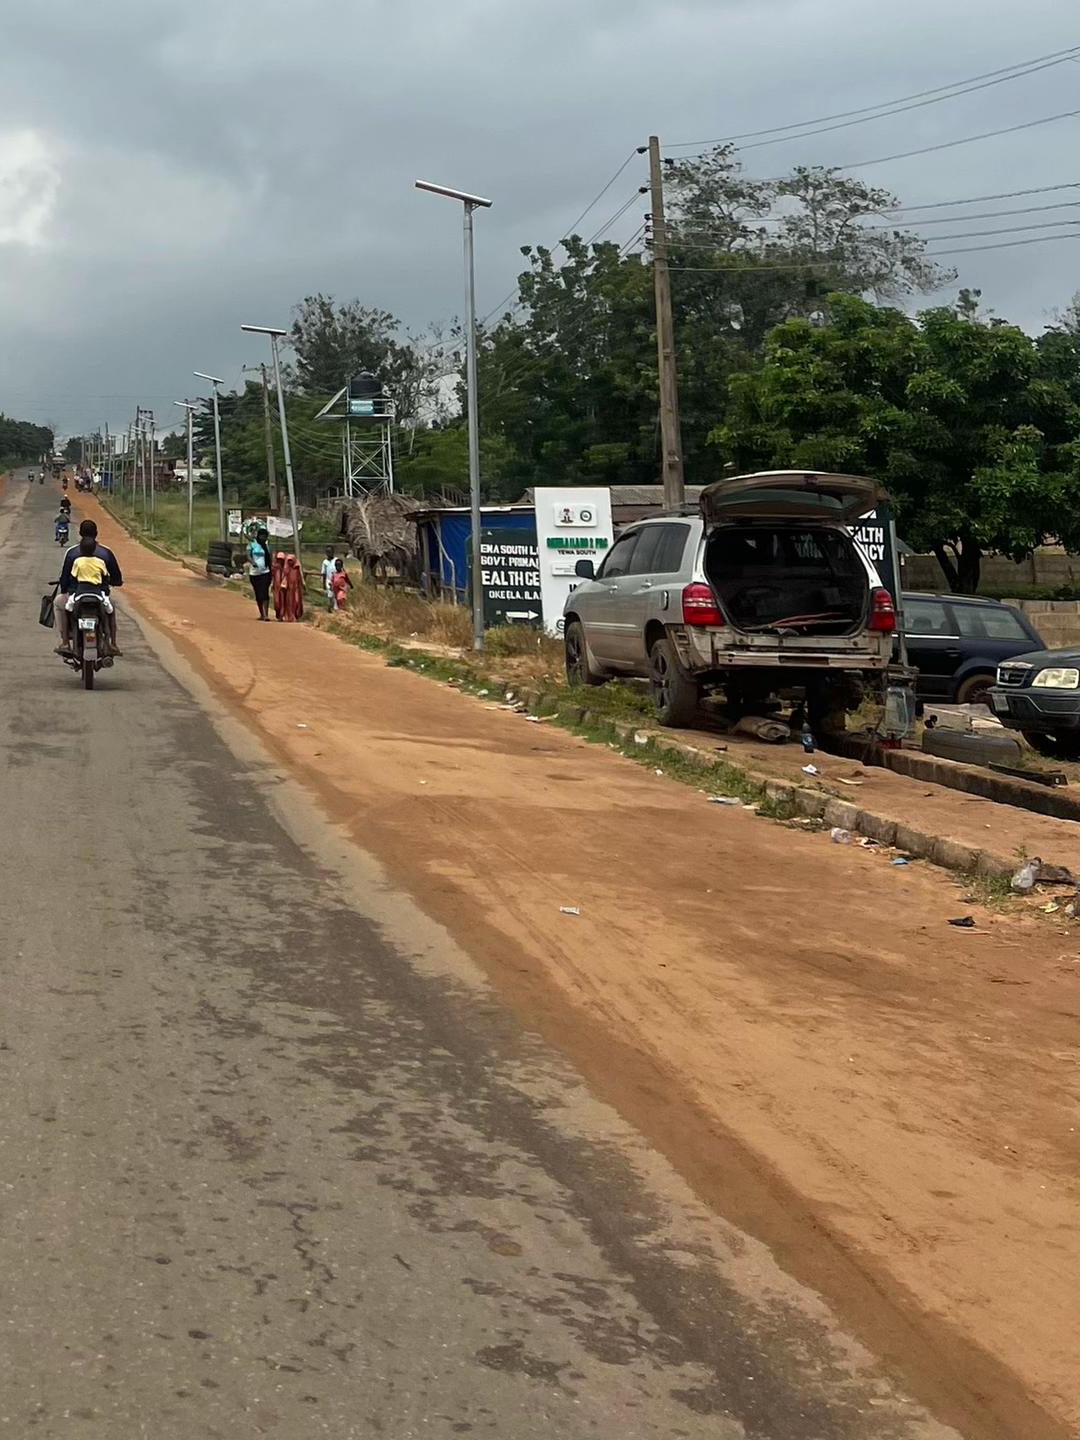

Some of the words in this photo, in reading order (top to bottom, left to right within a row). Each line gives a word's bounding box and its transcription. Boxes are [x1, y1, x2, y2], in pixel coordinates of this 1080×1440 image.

[500, 544, 528, 555] SOUTH
[481, 570, 525, 586] EALTH
[525, 571, 540, 586] CE
[524, 591, 540, 600] ILA
